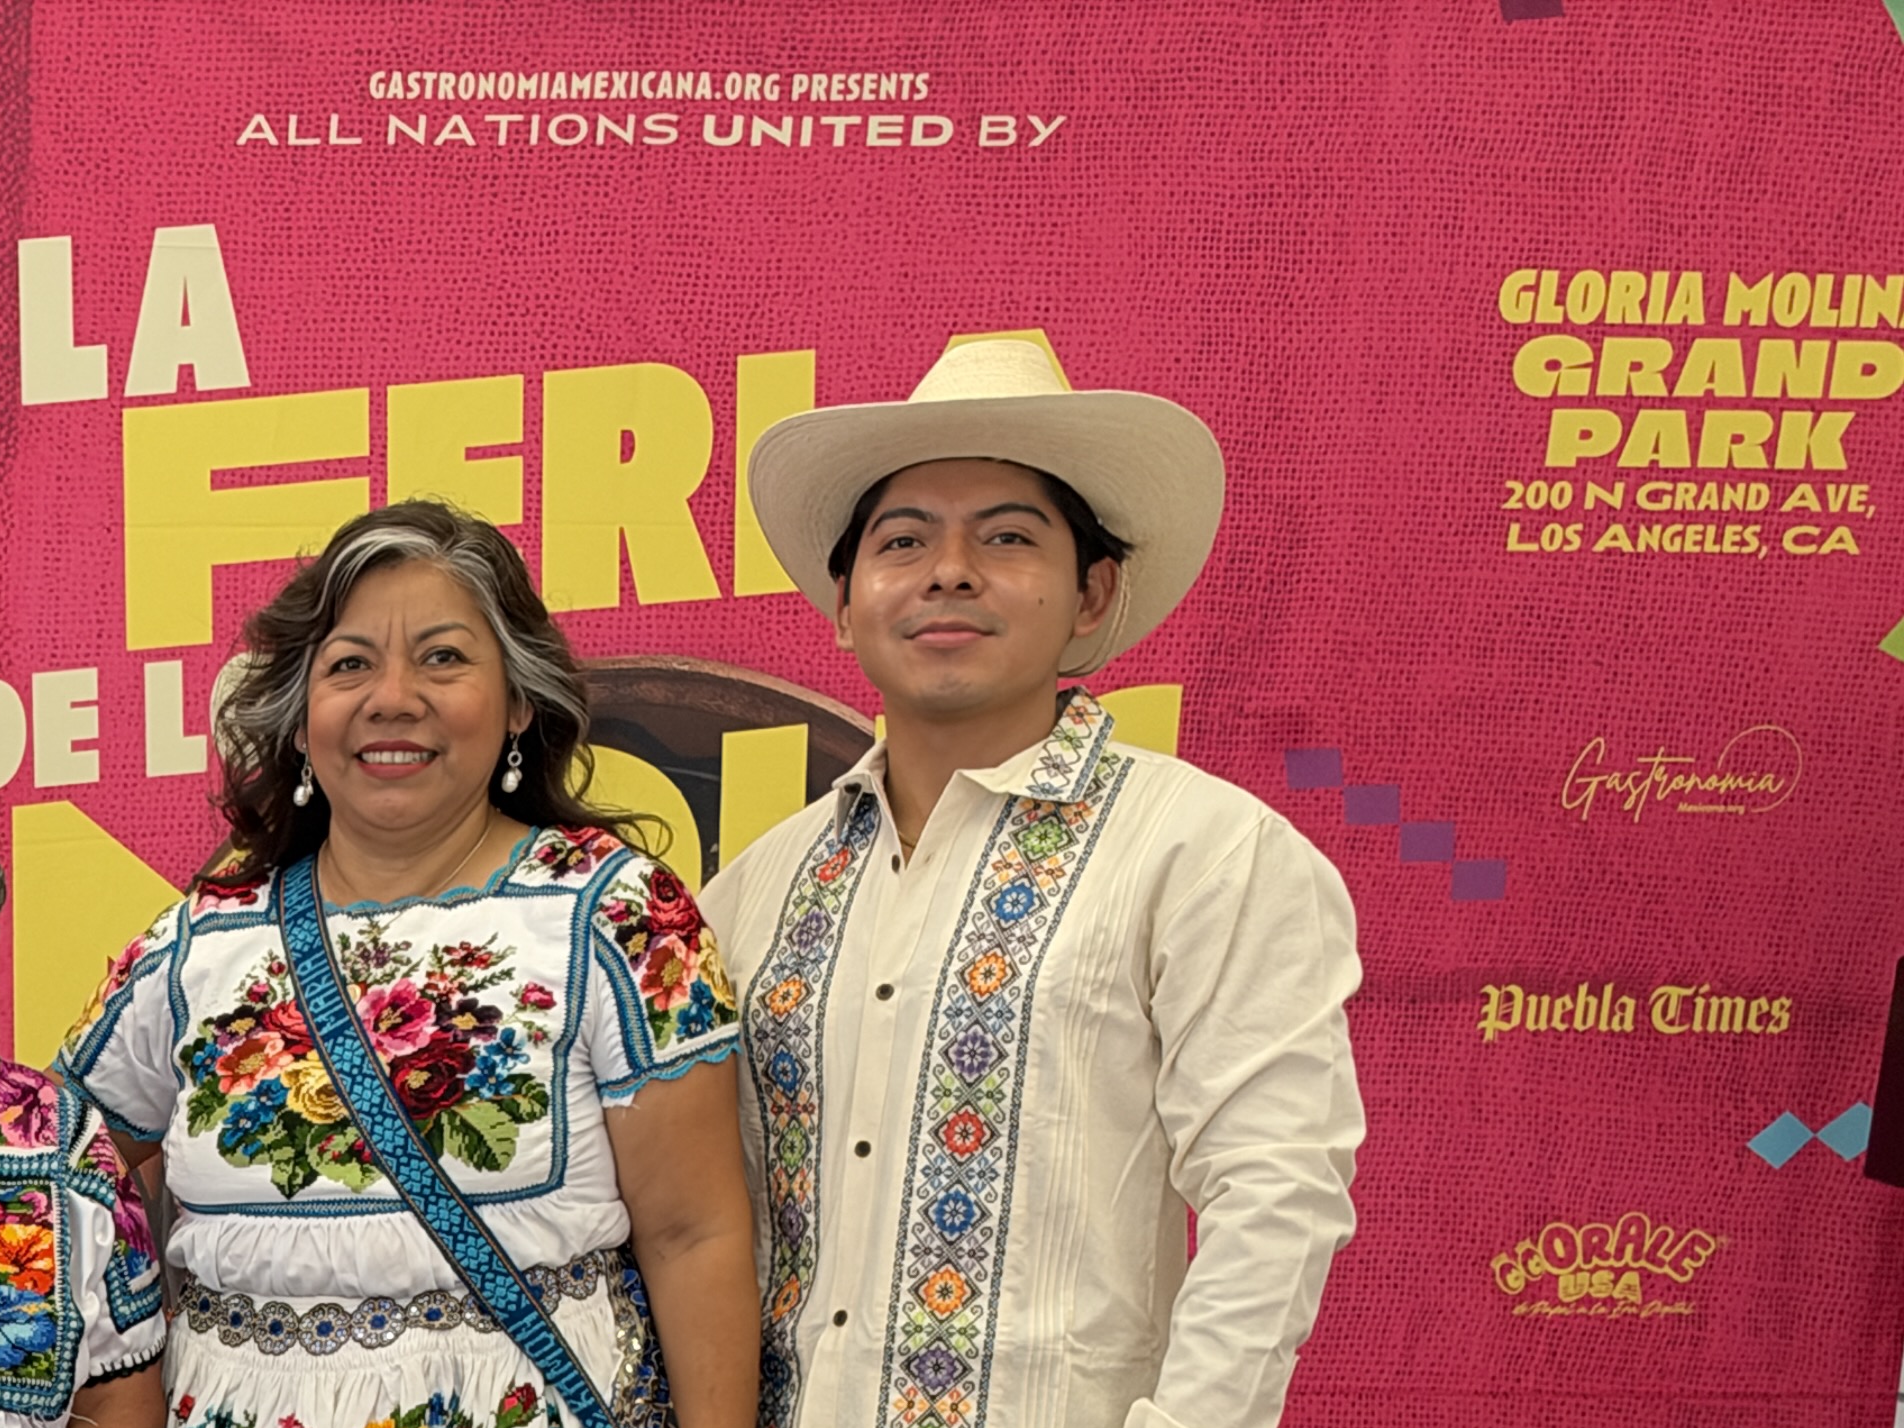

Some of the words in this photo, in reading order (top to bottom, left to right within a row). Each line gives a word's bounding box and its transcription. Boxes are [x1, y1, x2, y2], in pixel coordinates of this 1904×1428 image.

[370, 71, 779, 100] GASTRONOMIAMEXICANA.ORG
[792, 73, 929, 101] PRESENTS
[237, 114, 362, 145] ALL
[388, 113, 678, 145] NATIONS
[703, 115, 953, 146] UNITED
[979, 115, 1066, 146] BY
[18, 224, 249, 405] LA
[1499, 269, 1705, 325] GLORIA
[1724, 272, 1904, 329] MOLIN
[1513, 335, 1904, 399] GRAND
[1545, 409, 1855, 469] PARK
[122, 328, 1072, 651] FERI
[1502, 481, 1572, 509] 200
[1584, 481, 1625, 509] N
[1636, 482, 1770, 511] GRAND
[1780, 484, 1875, 518] AVE,
[1507, 523, 1583, 551] LOS
[1592, 524, 1767, 559] ANGELES,
[1783, 526, 1859, 554] CA
[297, 950, 349, 1036] MARIA
[1477, 982, 1635, 1042] Puebla
[1649, 984, 1791, 1034] Times
[1558, 1270, 1641, 1303] USA
